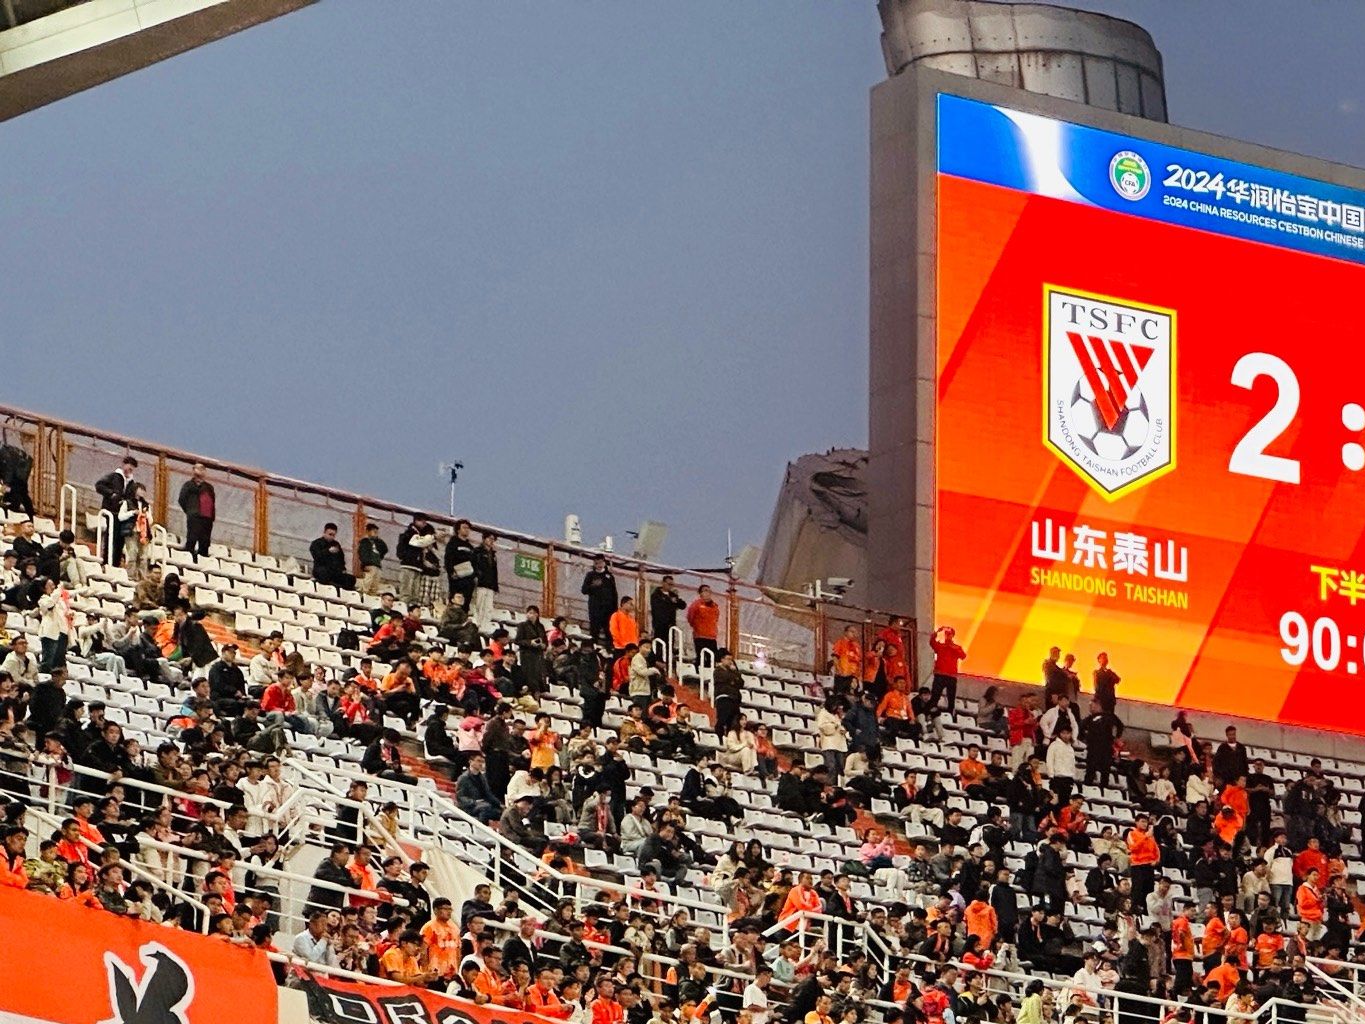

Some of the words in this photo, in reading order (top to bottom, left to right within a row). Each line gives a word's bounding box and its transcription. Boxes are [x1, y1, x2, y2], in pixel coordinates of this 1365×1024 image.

[1163, 194, 1188, 210] 2024
[1189, 202, 1219, 218] CHINA
[1220, 208, 1277, 229] RESOURCES
[1324, 229, 1364, 249] CHINESE
[1062, 301, 1159, 341] TSFC
[1057, 400, 1080, 457] SHANDONG
[1082, 454, 1119, 477] TAISHAN
[1120, 448, 1157, 476] FOOTBALL
[1031, 518, 1188, 582] 山东泰山
[1030, 567, 1117, 597] SHANDONG
[1124, 582, 1188, 609] TAISHAN
